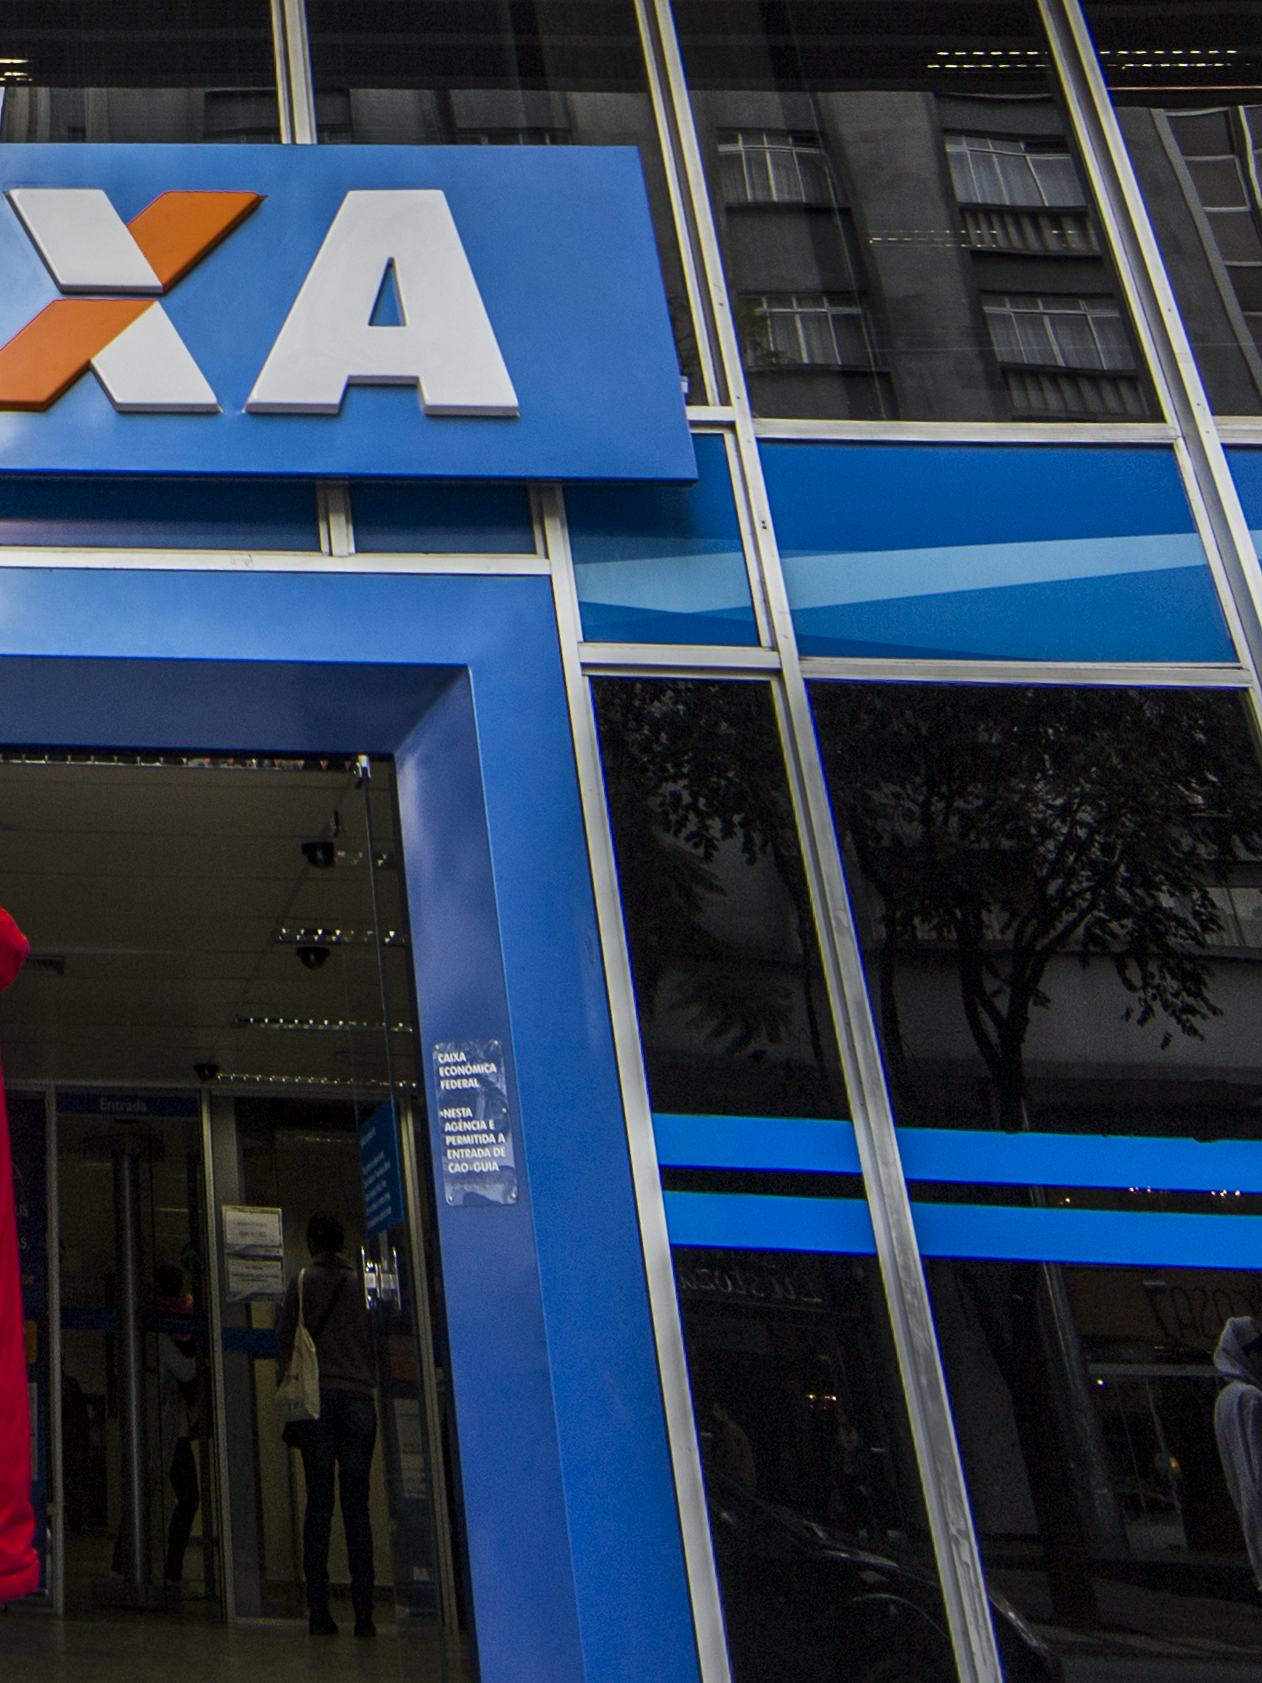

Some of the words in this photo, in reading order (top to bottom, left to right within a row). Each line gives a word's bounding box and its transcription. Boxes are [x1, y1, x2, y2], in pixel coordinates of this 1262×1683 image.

[438, 1051, 467, 1064] CAIXA
[440, 1078, 480, 1090] FEDERAL
[100, 1097, 148, 1112] Entrada
[443, 1107, 473, 1118] NESTA
[446, 1133, 496, 1146] PERMITIDA
[498, 1132, 506, 1143] A
[447, 1147, 491, 1160] ENTRADA
[493, 1146, 506, 1157] DE
